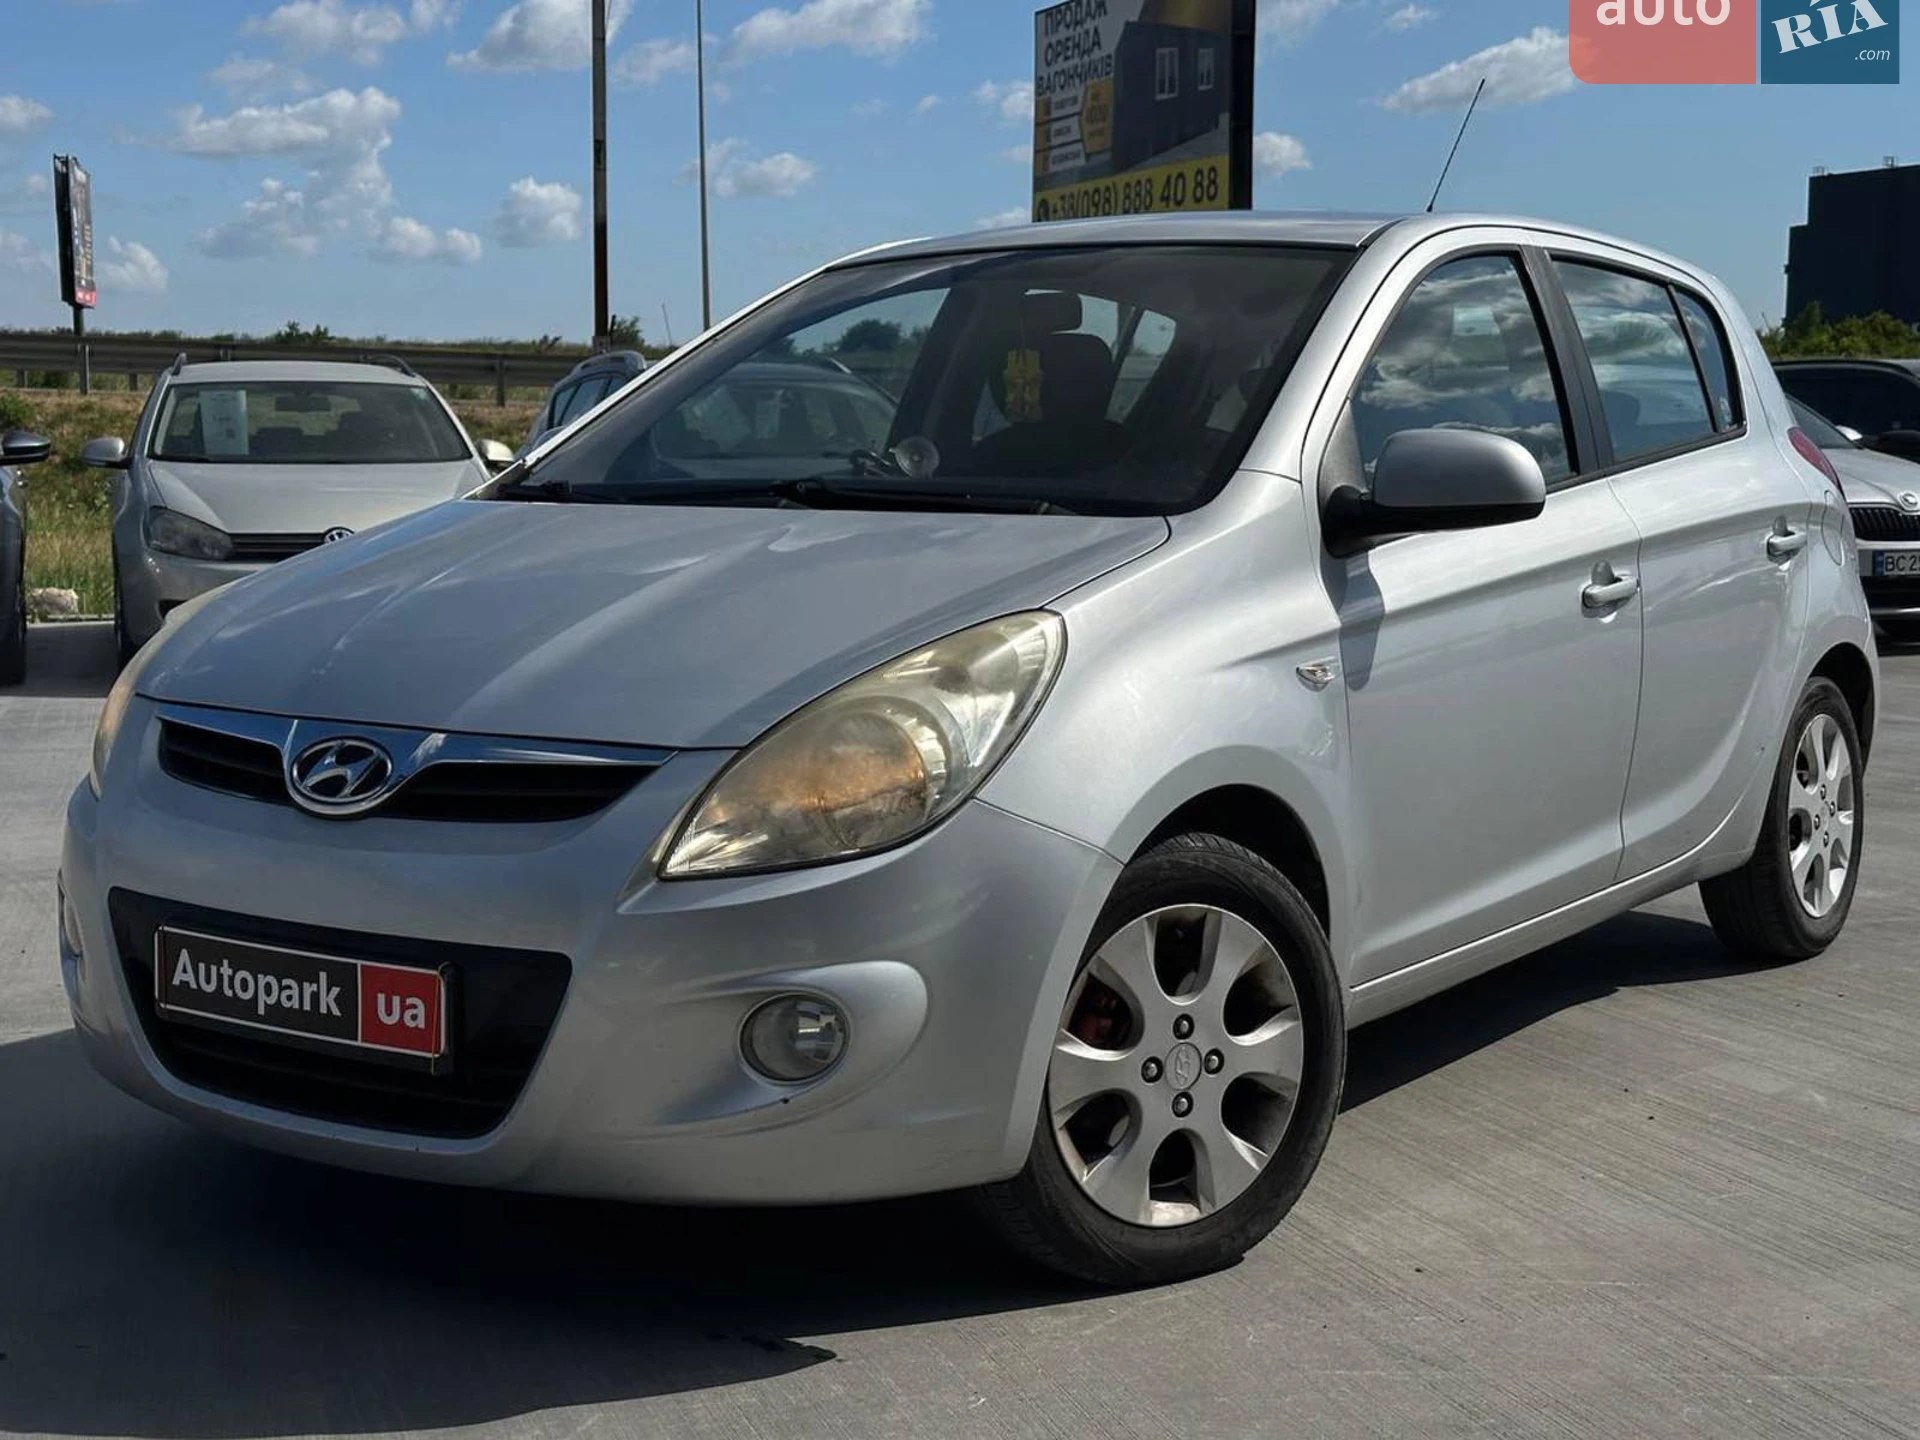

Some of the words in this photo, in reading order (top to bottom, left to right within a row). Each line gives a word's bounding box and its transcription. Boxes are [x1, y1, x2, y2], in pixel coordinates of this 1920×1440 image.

[1044, 0, 1107, 36] ПРОДАЖ
[1044, 26, 1101, 67] ОРЕНДА
[1037, 54, 1113, 96] ВАГОНЧИКІВ
[1122, 178, 1154, 213] 888
[1159, 172, 1186, 208] 40
[1193, 165, 1219, 203] 88
[1909, 555, 1920, 571] 2
[171, 948, 342, 1017] Autopark
[376, 992, 425, 1029] ua
